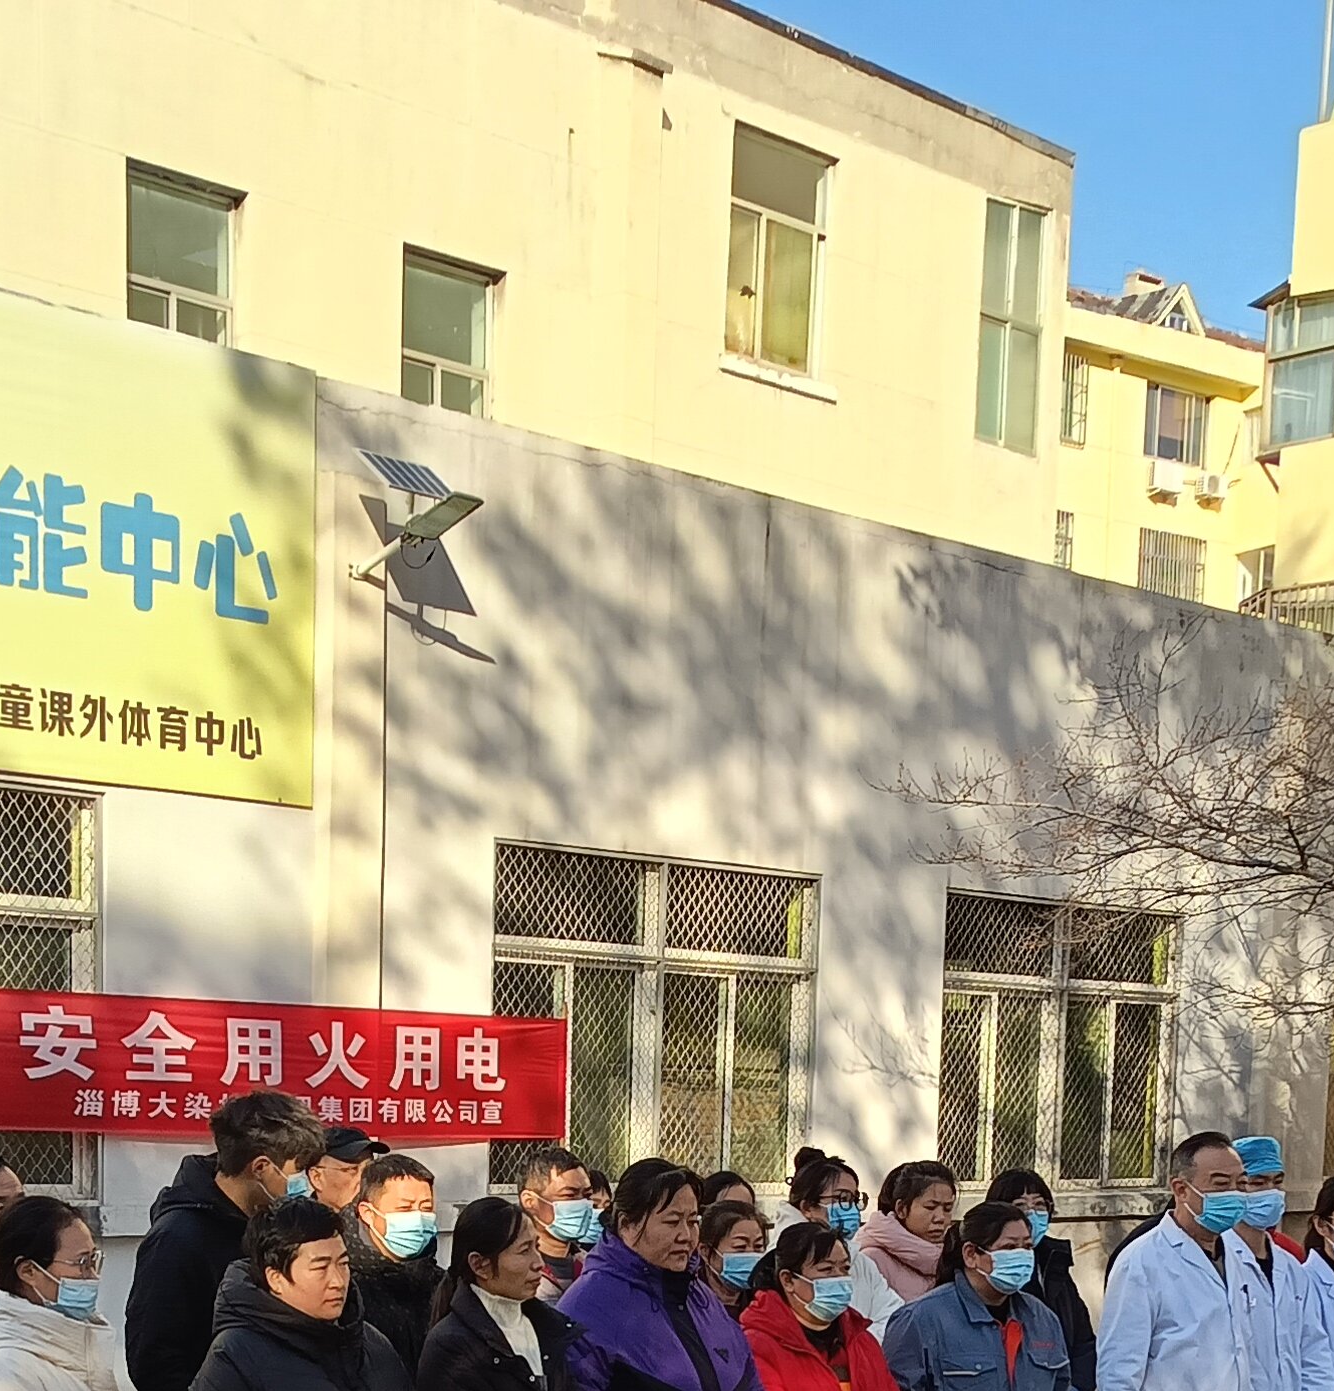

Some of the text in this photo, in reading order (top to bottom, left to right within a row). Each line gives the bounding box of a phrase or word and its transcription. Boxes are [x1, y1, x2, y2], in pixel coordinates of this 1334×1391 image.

[73, 1088, 503, 1125] 淄博大染集团有限公司宣
